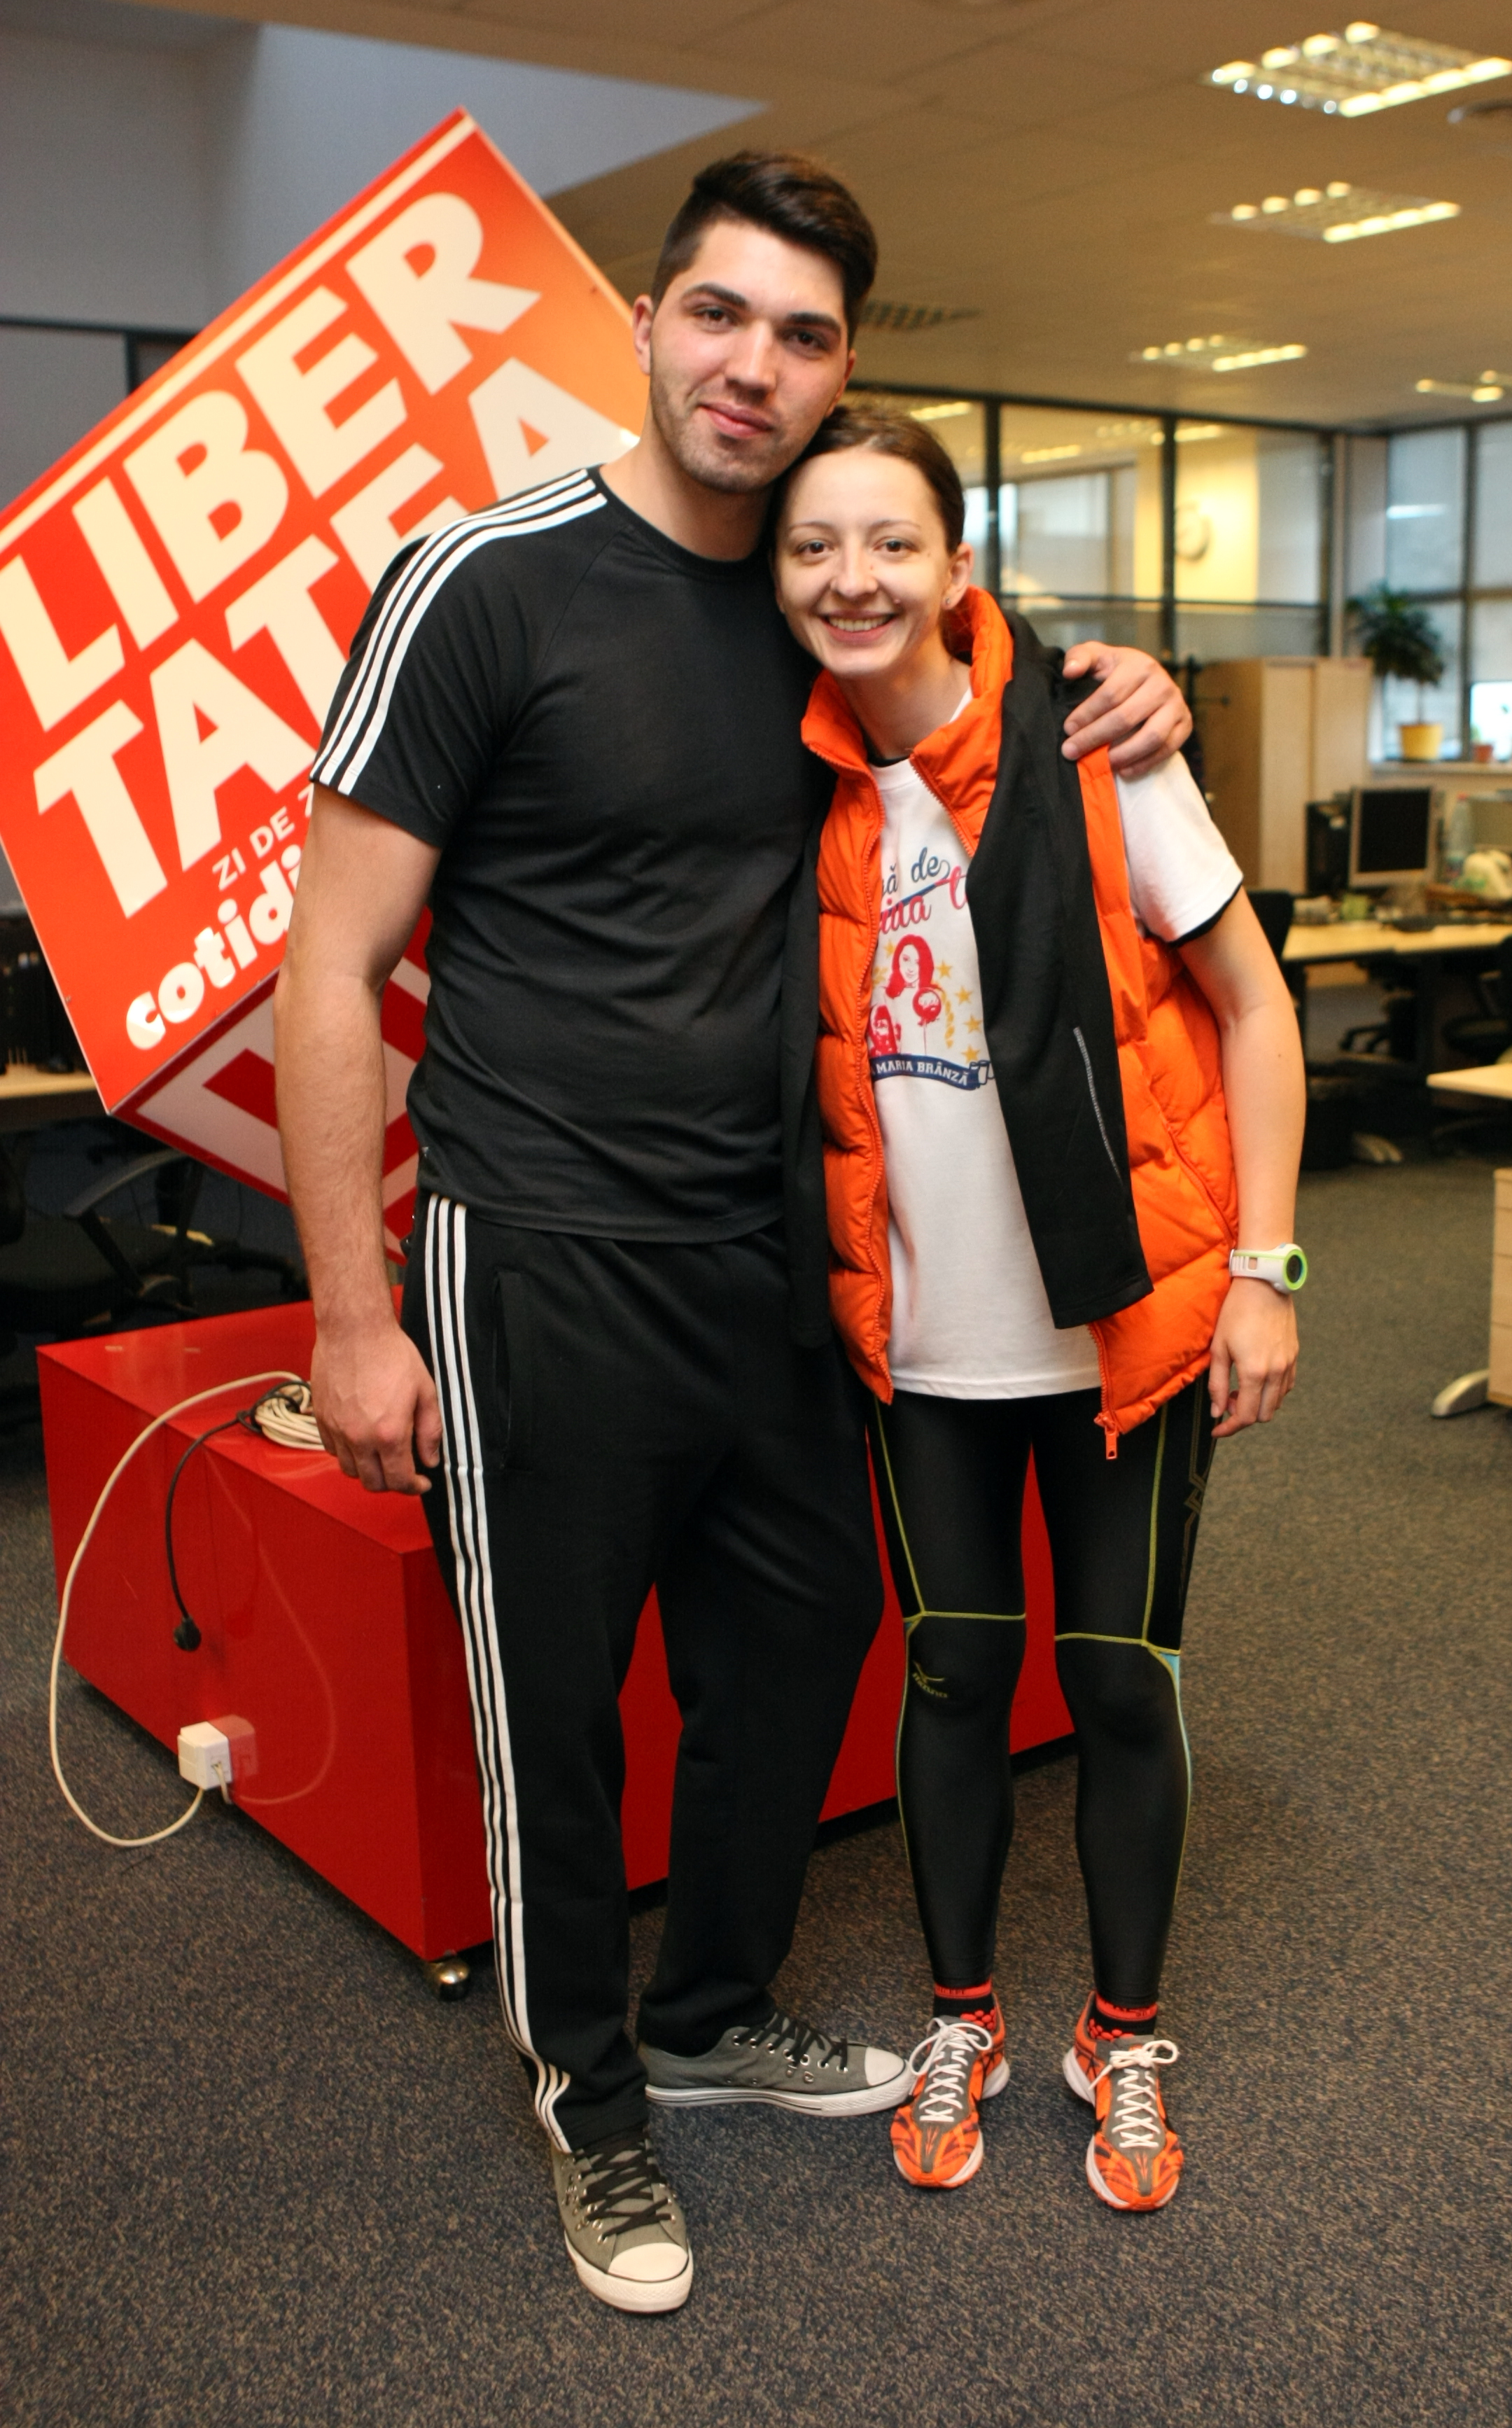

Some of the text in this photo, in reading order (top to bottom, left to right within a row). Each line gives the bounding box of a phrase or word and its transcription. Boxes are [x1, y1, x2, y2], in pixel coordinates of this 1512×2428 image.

[0, 192, 542, 733] LIBER
[212, 846, 246, 891] ZI
[249, 805, 295, 860] DE
[911, 846, 942, 883] de
[876, 1060, 913, 1075] MARIA
[916, 1061, 971, 1086] BRÂNZĂ
